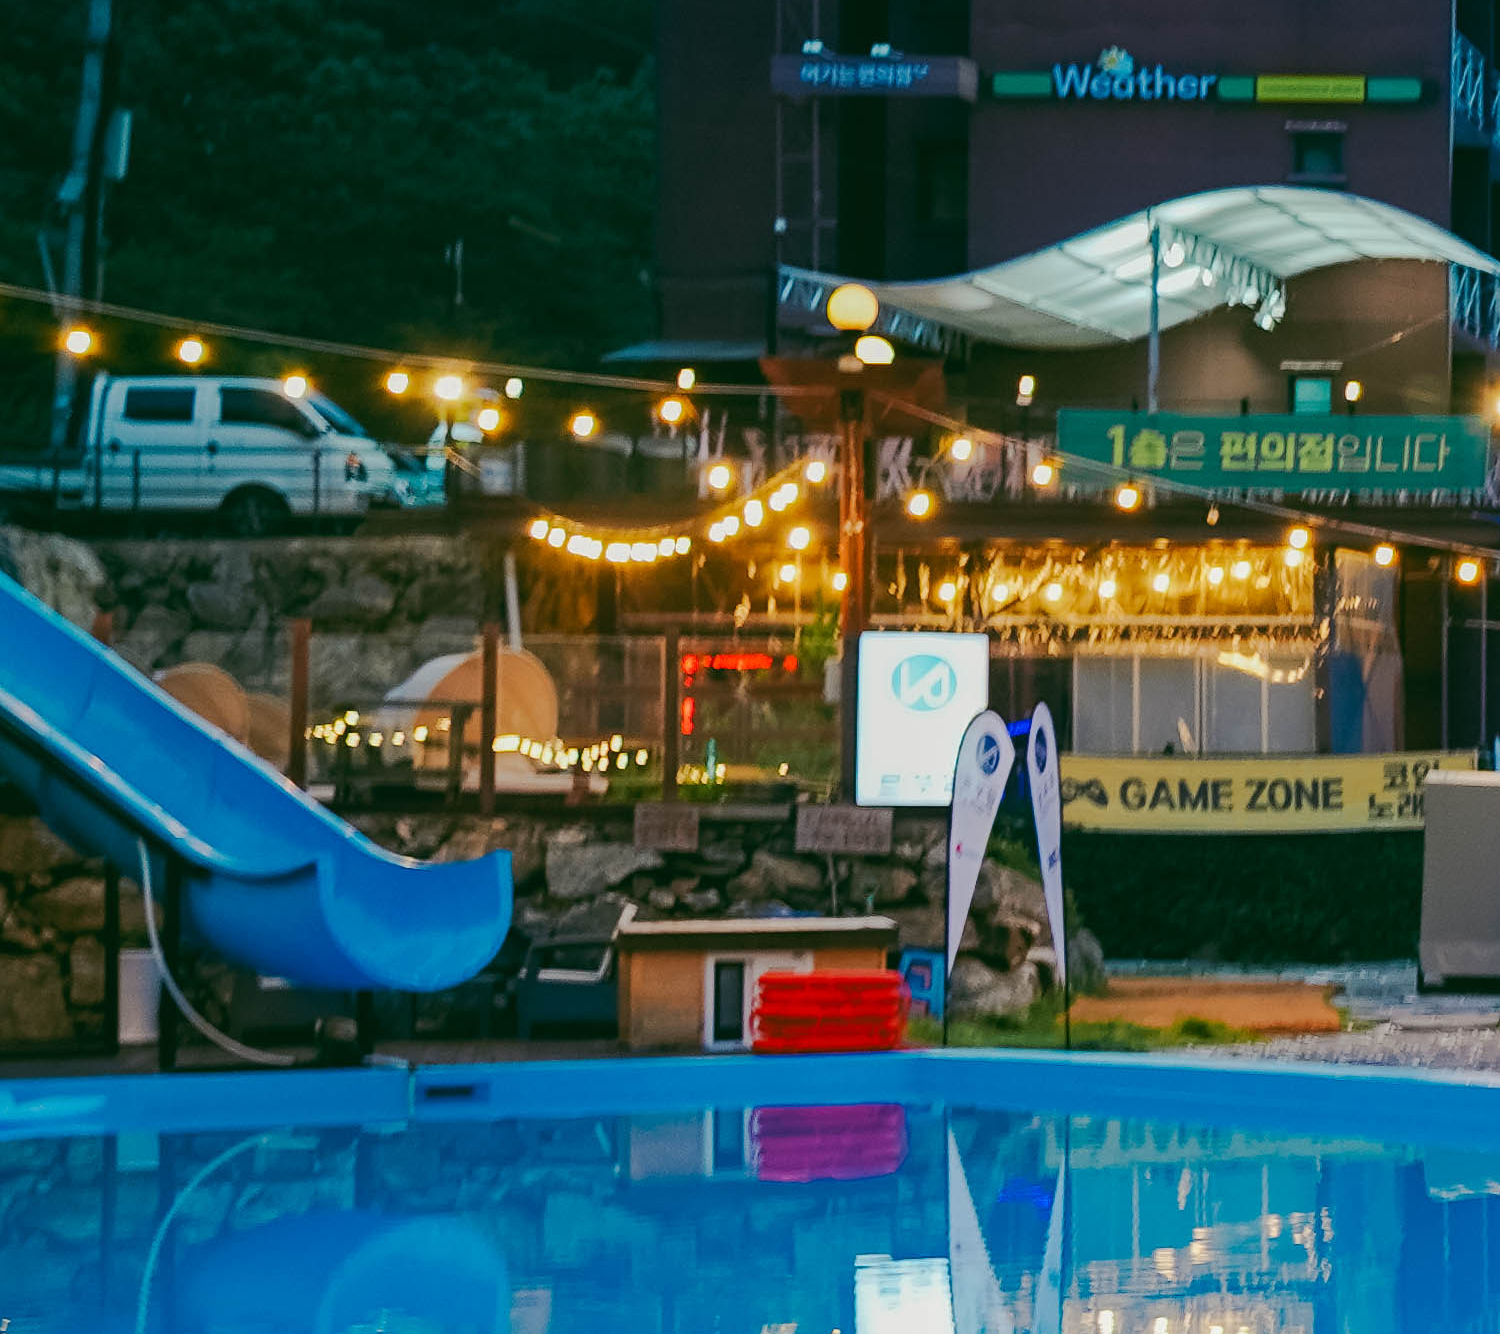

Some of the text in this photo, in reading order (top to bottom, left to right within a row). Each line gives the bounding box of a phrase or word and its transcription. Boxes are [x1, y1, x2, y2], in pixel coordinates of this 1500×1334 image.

[1053, 62, 1217, 99] Weather
[1220, 430, 1451, 473] 편의점입니다
[1119, 776, 1344, 812] GAME ZONE
